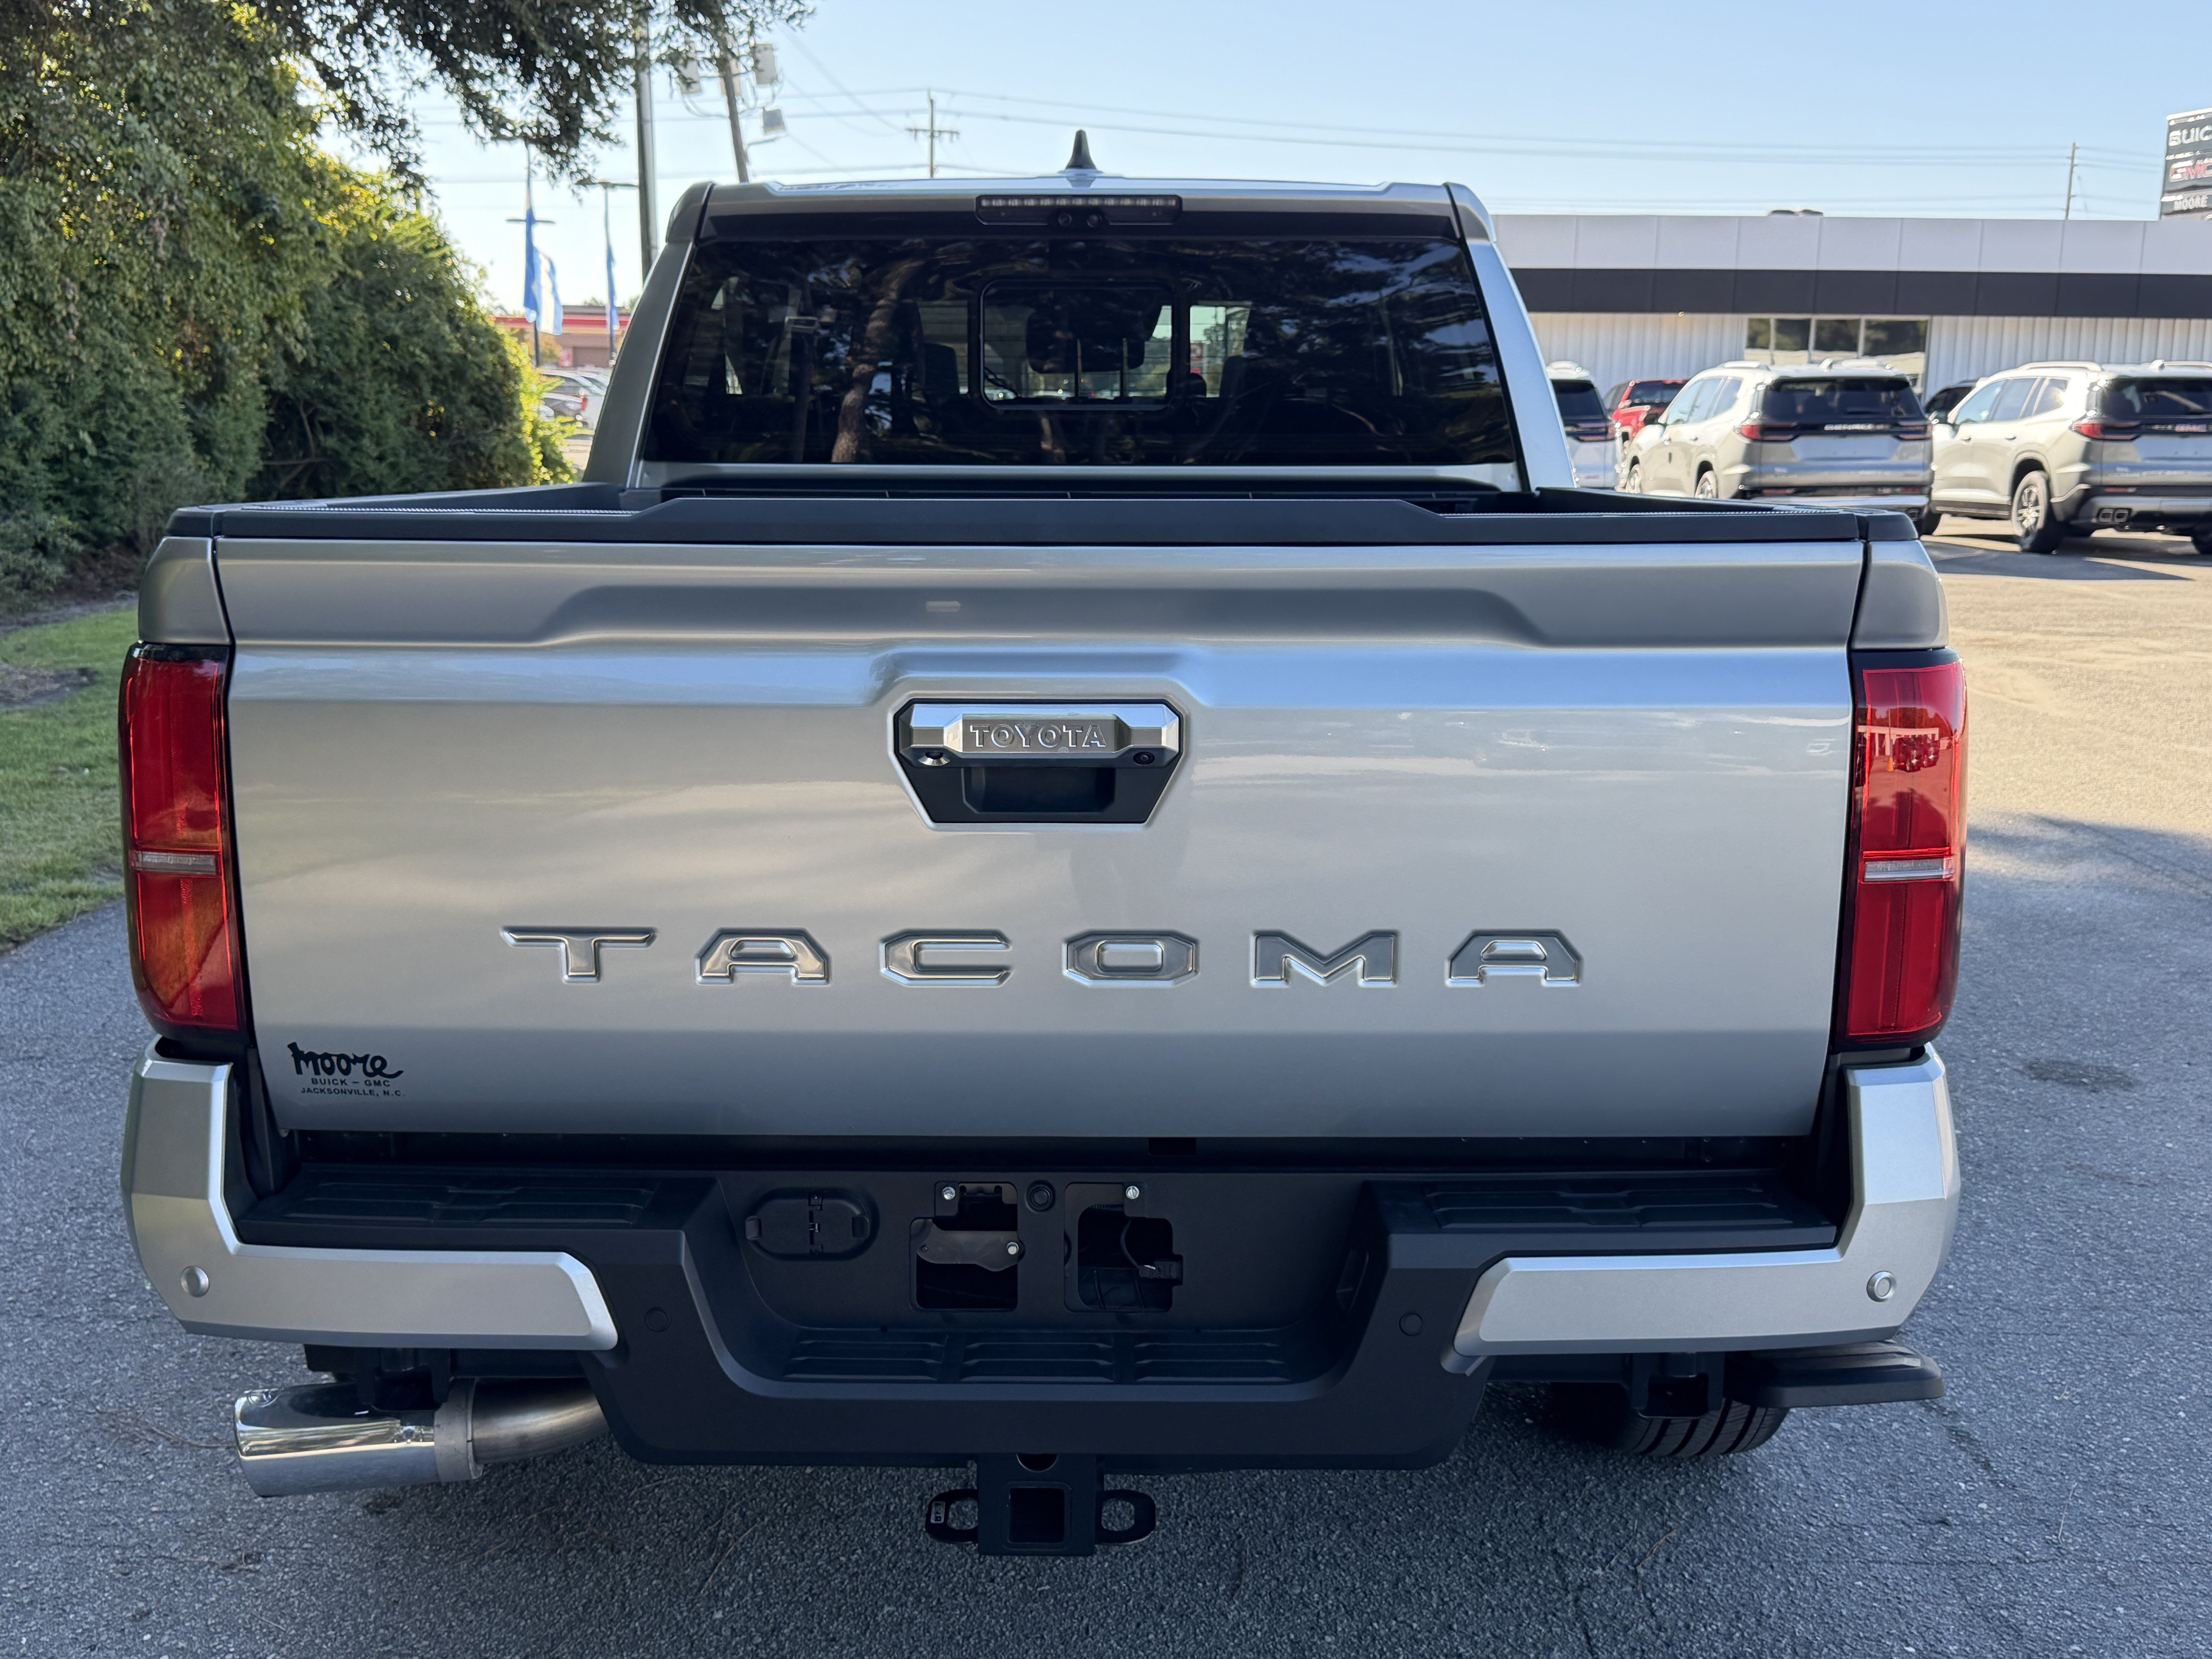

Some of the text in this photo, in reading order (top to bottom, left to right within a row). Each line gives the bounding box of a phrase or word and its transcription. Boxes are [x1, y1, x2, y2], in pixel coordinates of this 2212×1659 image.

[2173, 194, 2209, 211] MOORE
[970, 724, 1107, 748] TOYOTA
[501, 926, 1584, 988] TACOMA
[311, 1077, 348, 1085] BUICK
[301, 1087, 379, 1097] JACKSONVILLE,
